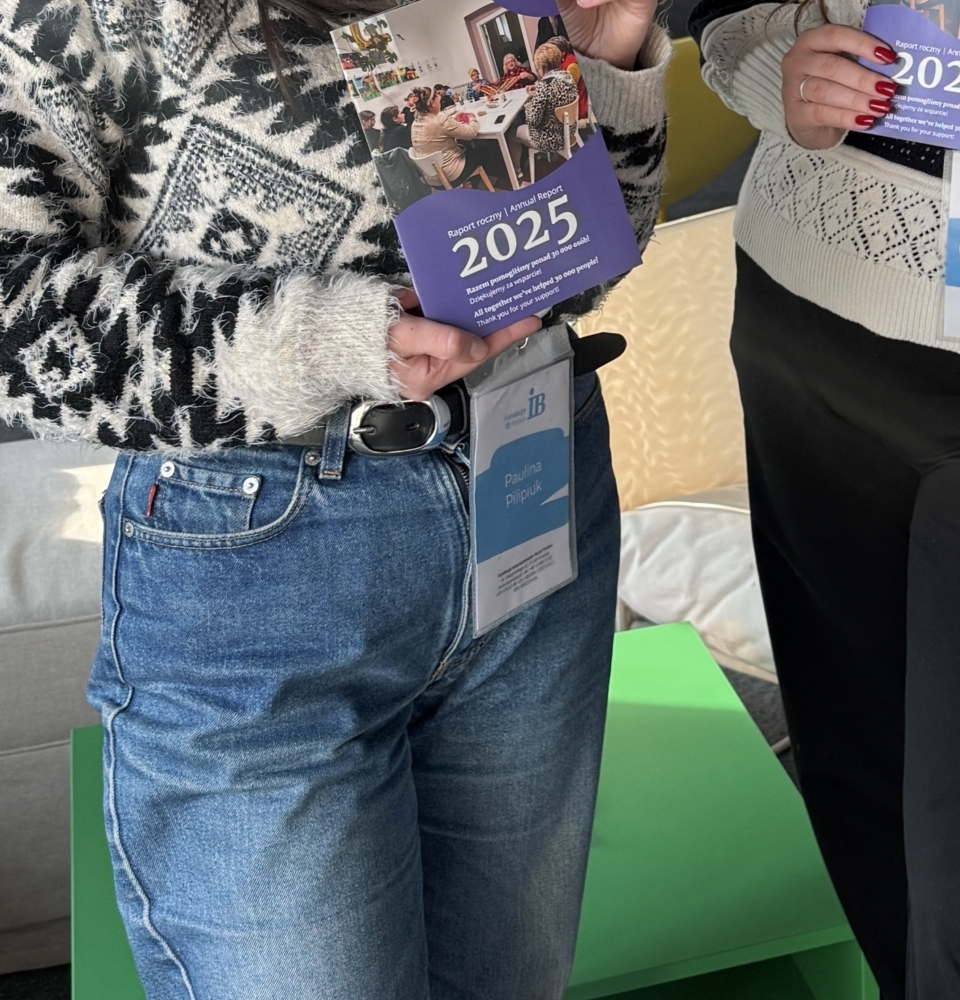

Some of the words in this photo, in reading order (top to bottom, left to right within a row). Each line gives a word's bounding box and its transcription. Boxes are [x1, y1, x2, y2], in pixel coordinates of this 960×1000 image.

[895, 40, 918, 50] Raport
[919, 45, 941, 55] roczny
[447, 222, 476, 238] Raport
[476, 211, 502, 227] roczny
[510, 196, 537, 212] Annual
[537, 185, 563, 202] Report
[452, 194, 578, 278] 2025
[490, 263, 531, 287] pomogliśmy
[531, 253, 552, 269] ponad
[551, 249, 560, 260] 30
[560, 245, 573, 254] 000
[573, 234, 591, 248] osób!
[514, 268, 543, 287] wsparcie!
[474, 308, 484, 318] All
[484, 297, 513, 314] together
[532, 277, 555, 294] helped
[554, 273, 564, 283] 30
[563, 268, 576, 278] 000
[576, 256, 600, 274] people!
[476, 314, 498, 328] Thank
[497, 310, 510, 321] you
[509, 304, 519, 313] for
[519, 299, 534, 311] your
[534, 286, 560, 303] support!
[505, 461, 542, 488] Paulina
[506, 479, 542, 509] Pilipiuk
